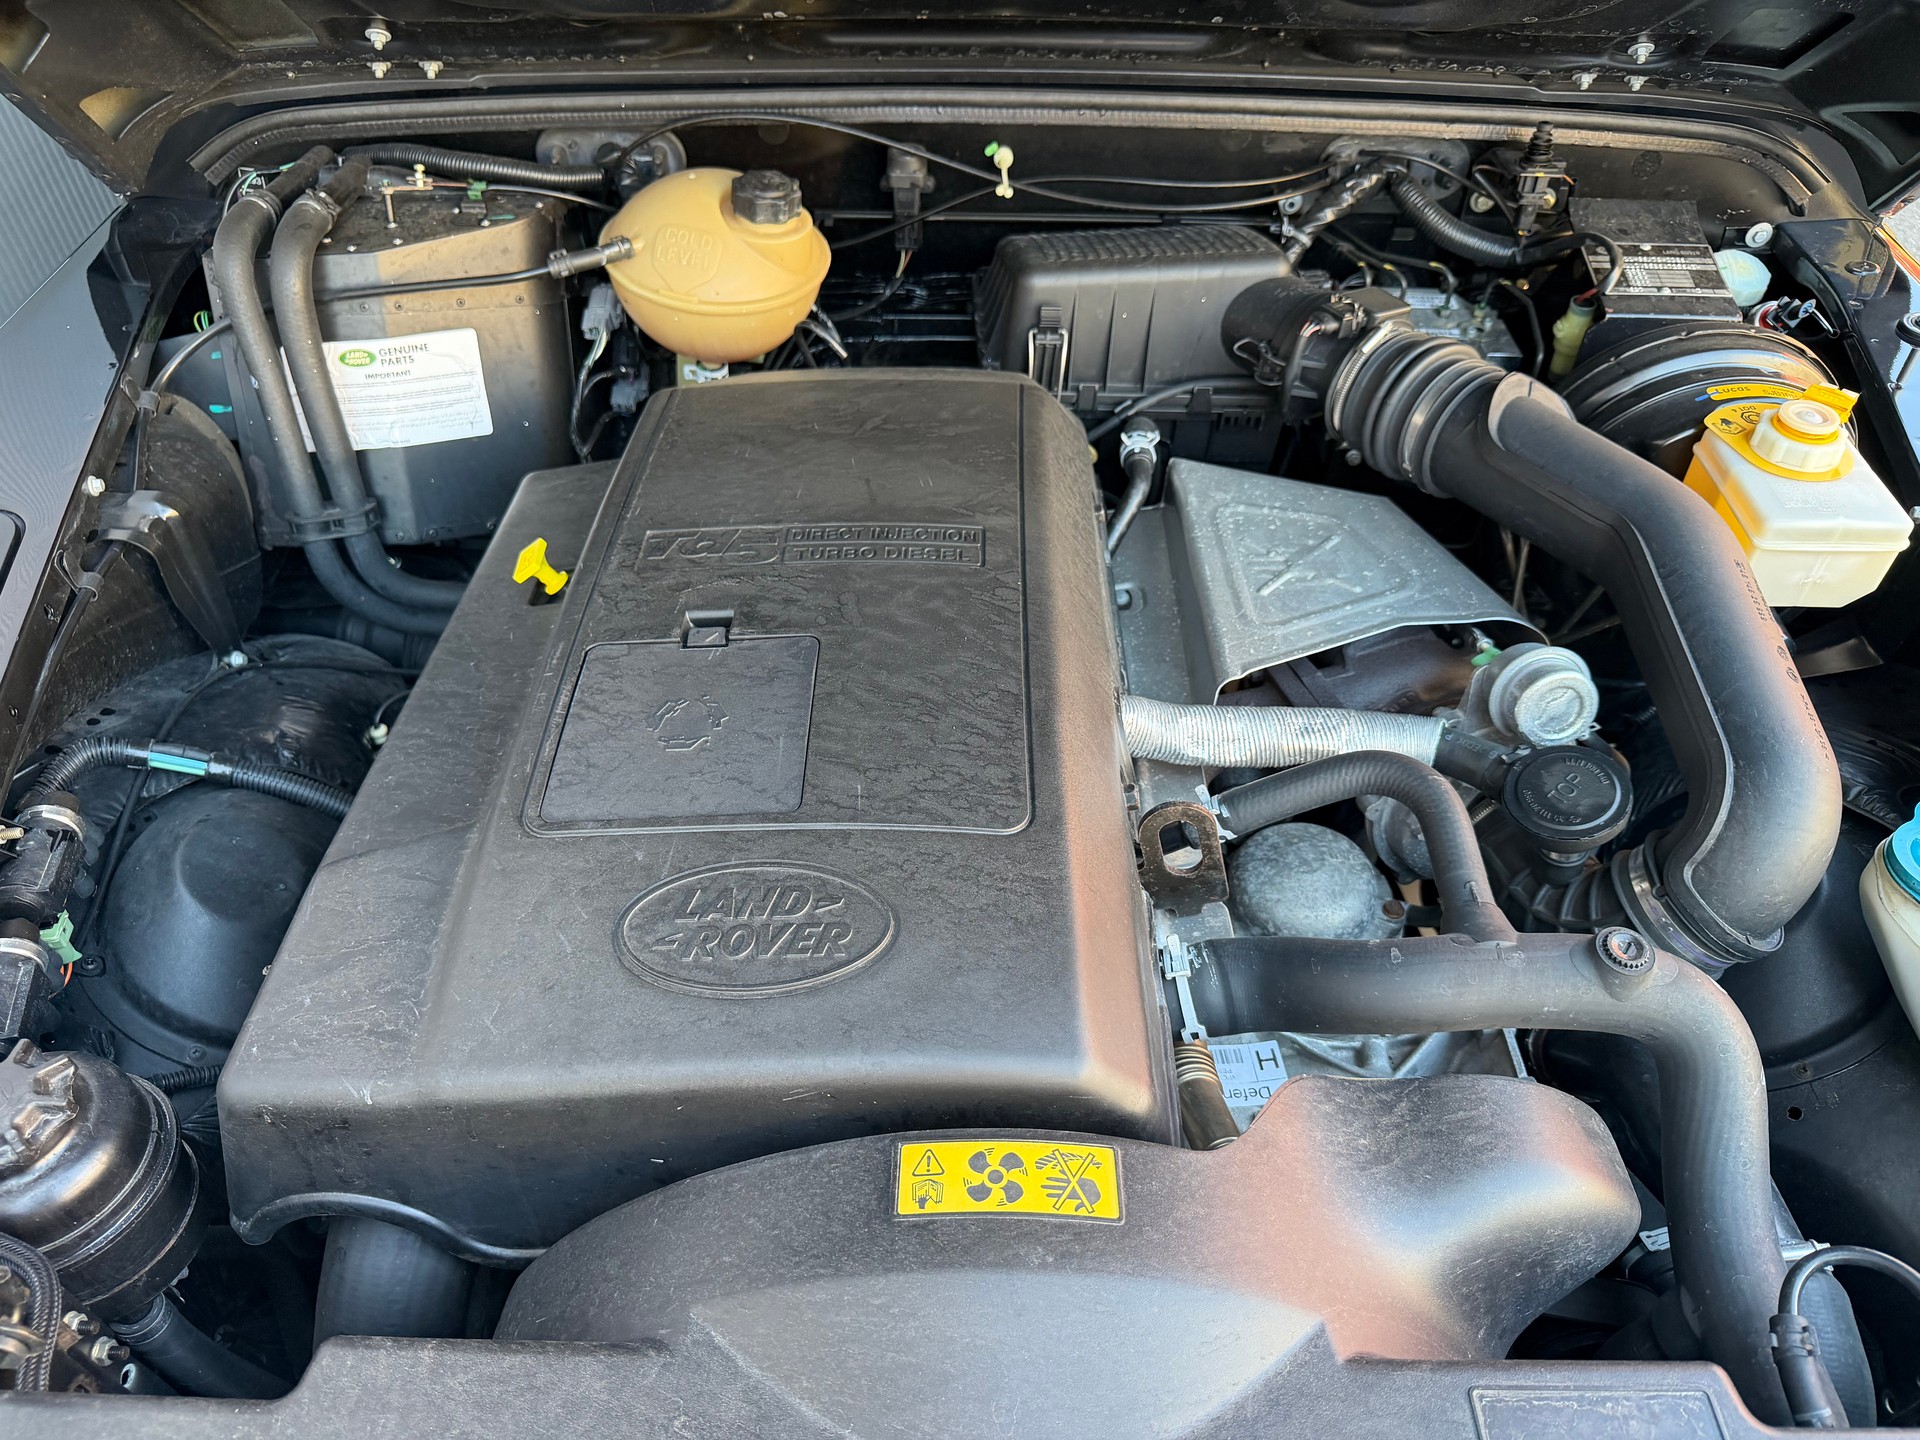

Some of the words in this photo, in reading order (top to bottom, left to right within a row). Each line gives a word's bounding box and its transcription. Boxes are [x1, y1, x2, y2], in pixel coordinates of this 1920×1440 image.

[378, 343, 430, 357] GENUINE
[380, 355, 415, 366] PARTS
[364, 370, 411, 380] IMPORTANT
[792, 527, 864, 541] DIRECT
[870, 528, 977, 543] INJECTION
[795, 546, 877, 561] TURBO
[884, 546, 972, 562] DIESEL
[1547, 772, 1582, 804] TOP
[675, 886, 813, 922] LAND
[681, 923, 853, 961] ROVER
[1255, 1048, 1279, 1071] H
